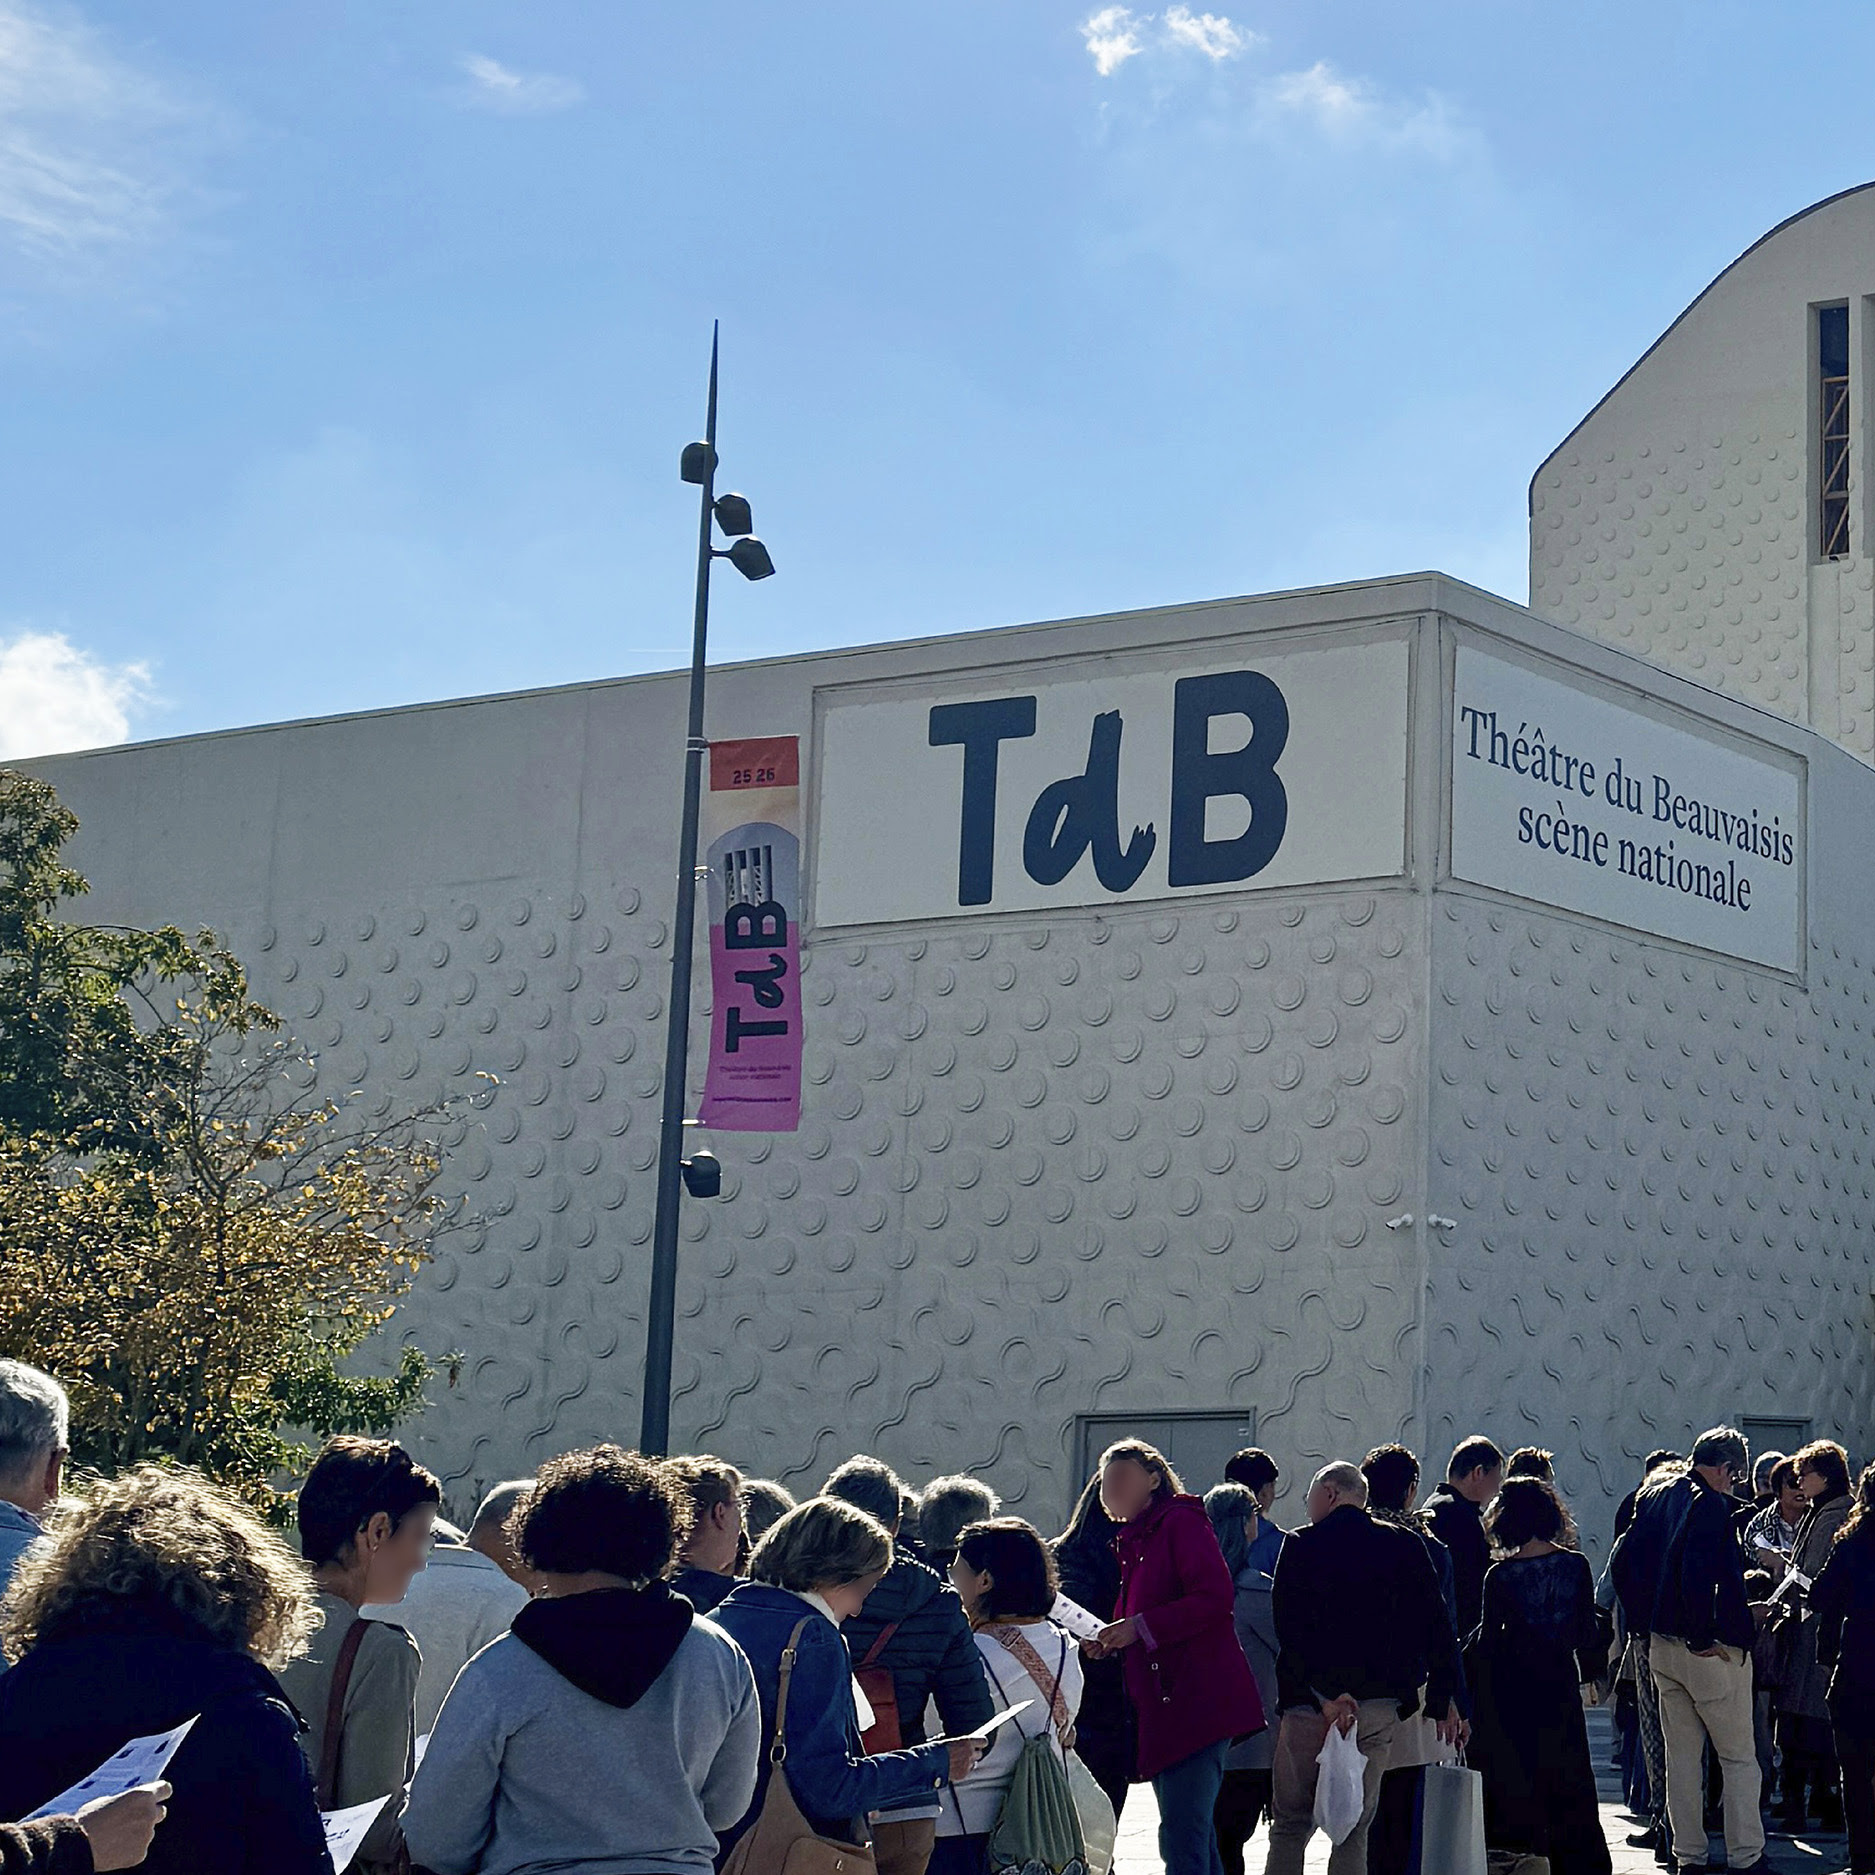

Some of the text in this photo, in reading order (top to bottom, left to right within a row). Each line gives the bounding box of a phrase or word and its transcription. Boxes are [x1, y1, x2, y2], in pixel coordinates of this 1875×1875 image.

[733, 767, 775, 784] 25 26
[929, 669, 1289, 906] TdB
[1461, 706, 1793, 866] Théâtre du Beauvaisis
[1518, 801, 1752, 912] scène nationale
[725, 901, 788, 1053] TdB
